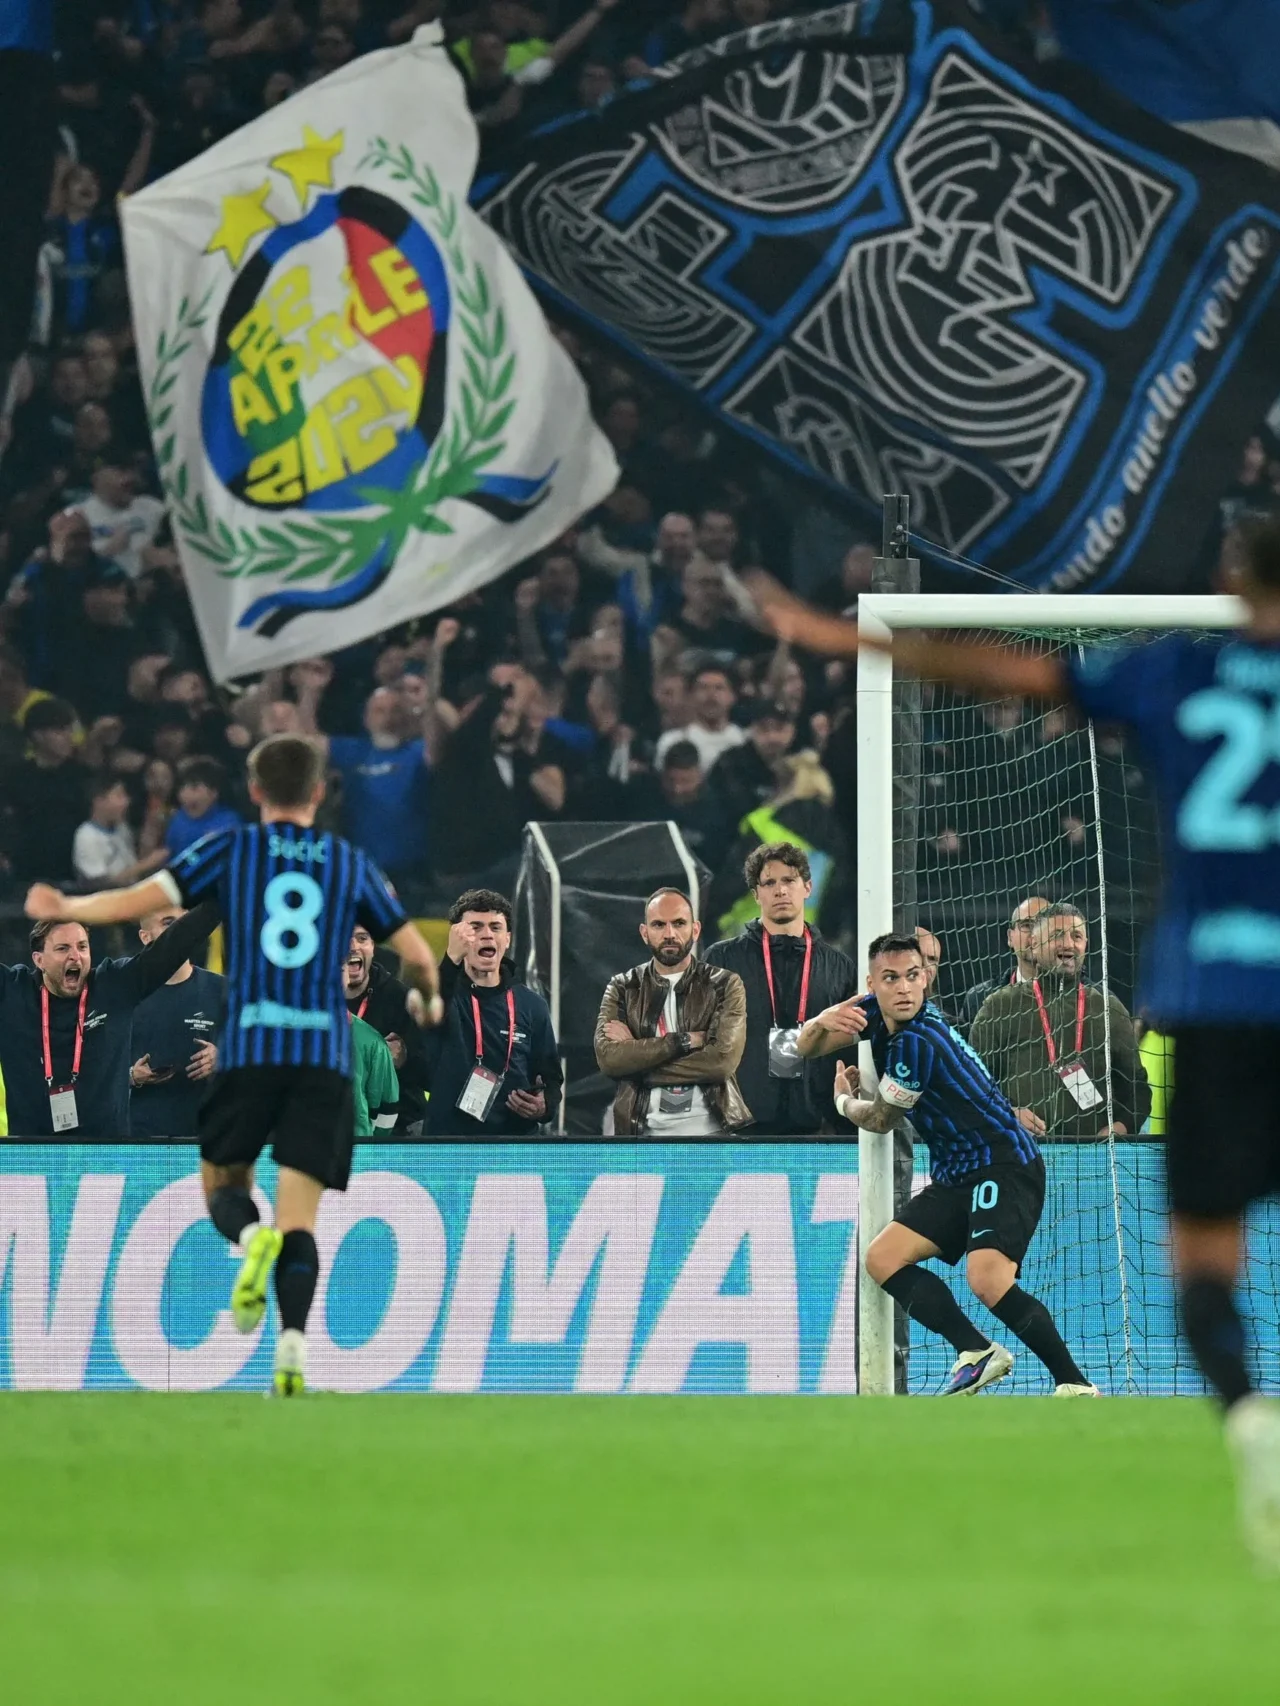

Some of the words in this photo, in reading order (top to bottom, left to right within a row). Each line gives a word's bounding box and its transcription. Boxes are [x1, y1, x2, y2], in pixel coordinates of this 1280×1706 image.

[1122, 361, 1197, 494] anello
[1193, 227, 1270, 350] verde
[245, 353, 423, 503] 2024
[260, 869, 324, 969] 8
[971, 1180, 999, 1213] 10
